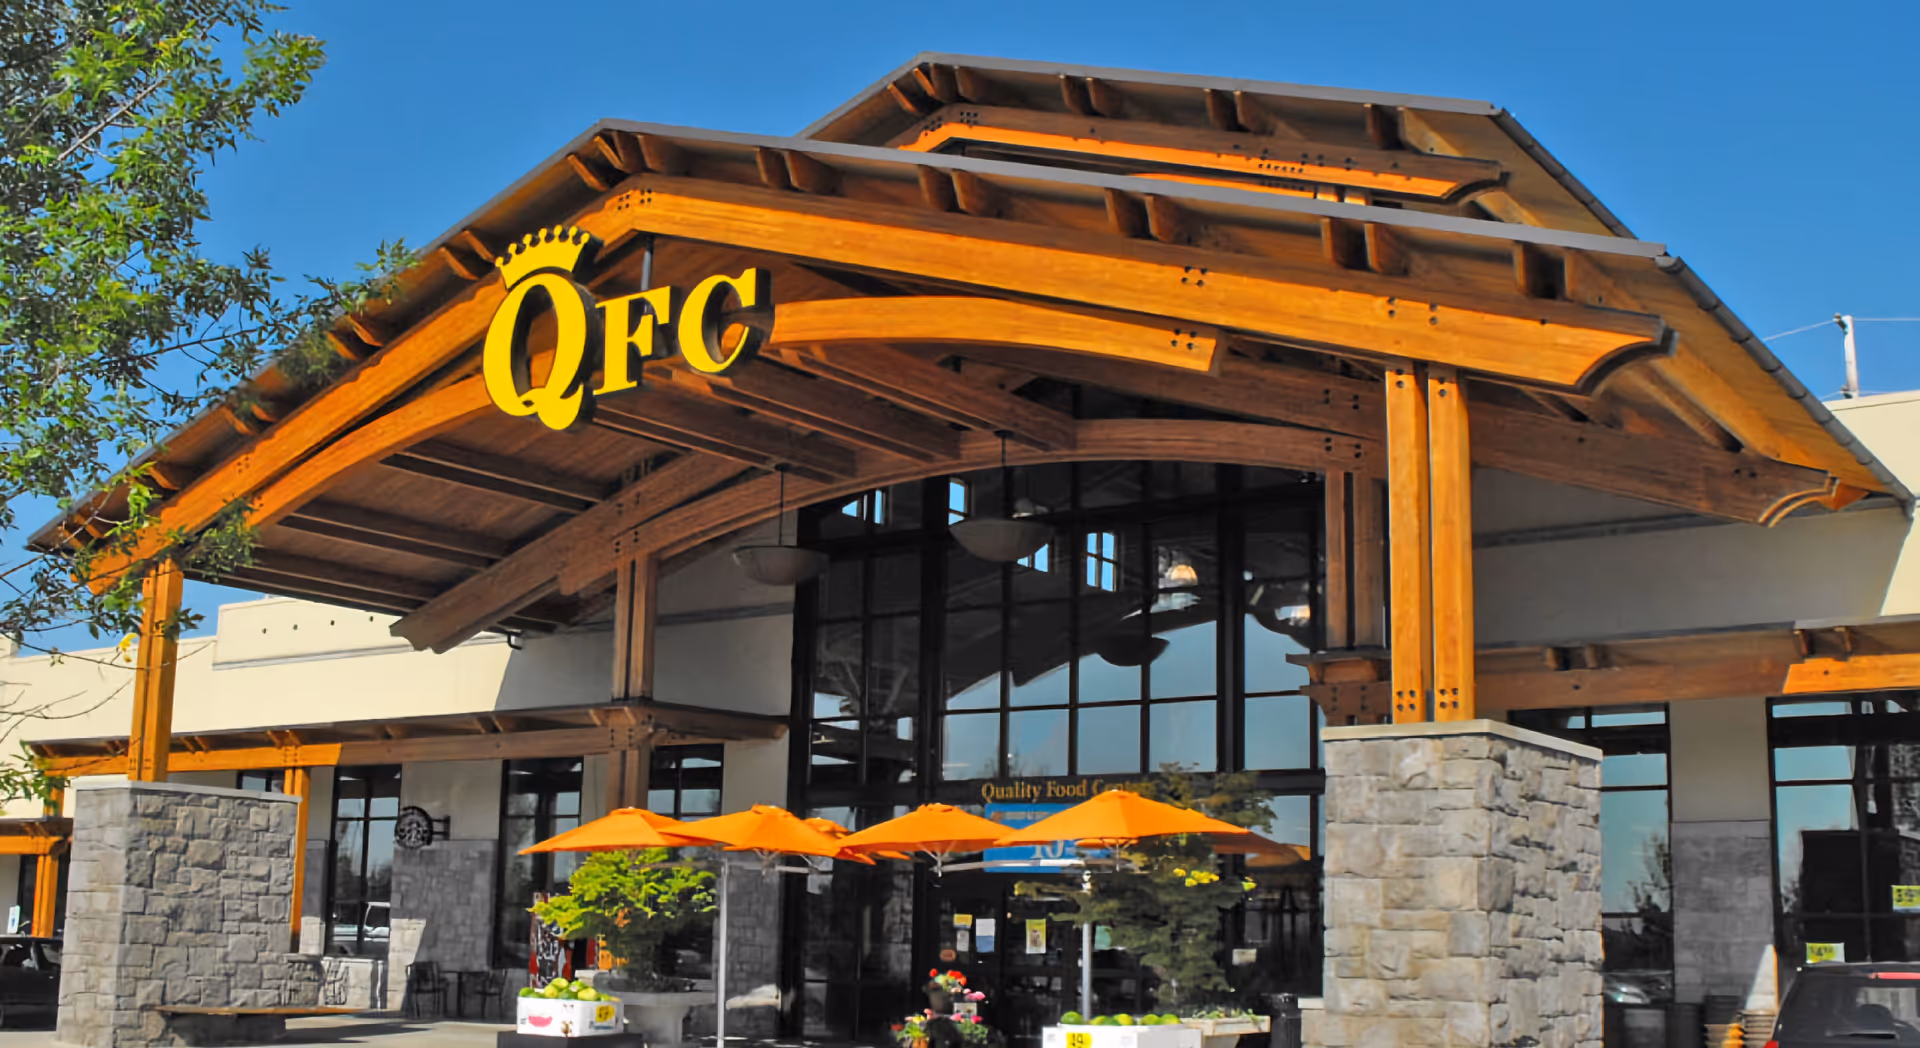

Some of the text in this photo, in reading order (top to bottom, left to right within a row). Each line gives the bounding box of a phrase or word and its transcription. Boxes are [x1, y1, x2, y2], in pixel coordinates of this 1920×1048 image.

[483, 266, 757, 431] QFC
[981, 781, 1042, 803] Quality
[1046, 779, 1088, 798] Food
